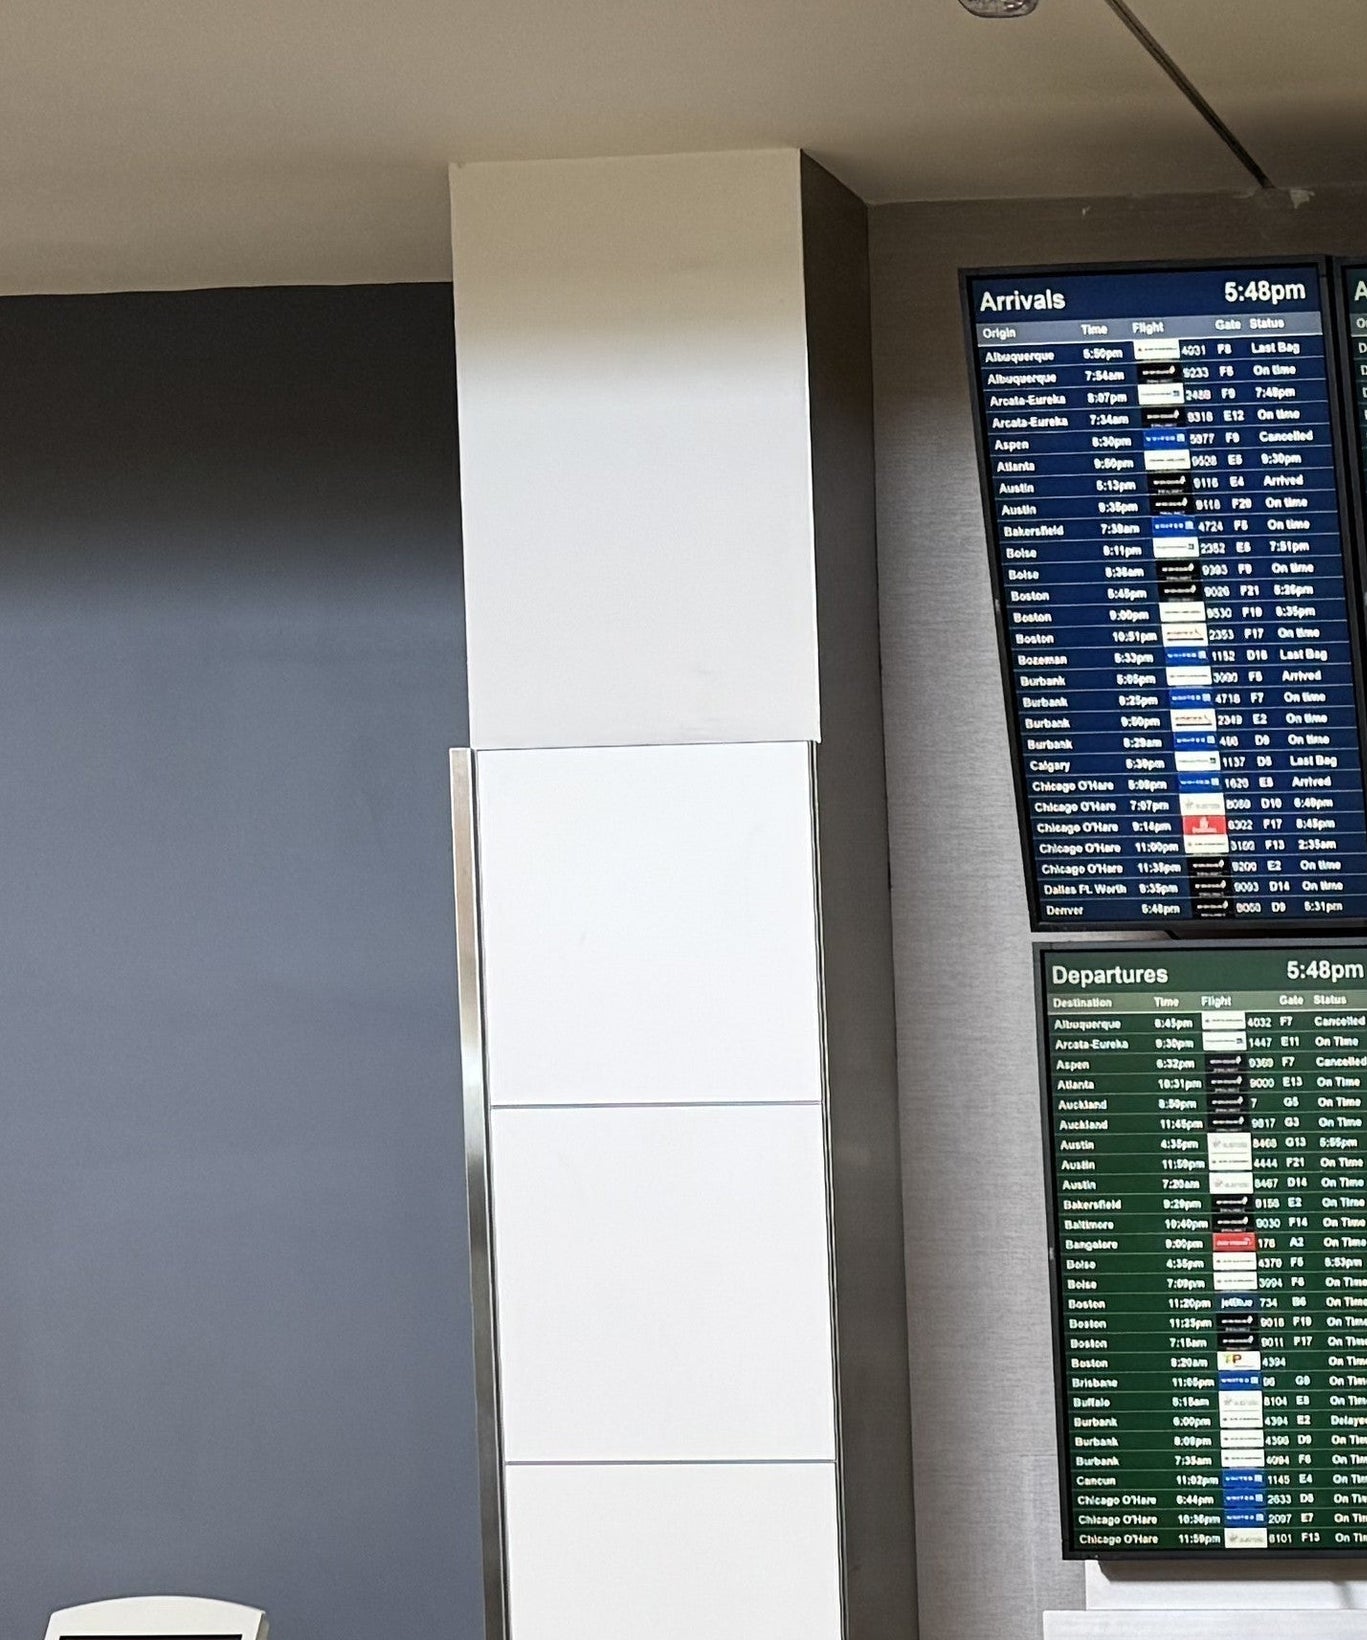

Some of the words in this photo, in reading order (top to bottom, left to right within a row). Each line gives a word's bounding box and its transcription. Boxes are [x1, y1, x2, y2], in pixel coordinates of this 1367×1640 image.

[979, 288, 1066, 312] Arrivals
[1224, 280, 1306, 305] 5:48pm
[982, 327, 1017, 341] Origin
[1080, 323, 1108, 335] Time
[1131, 321, 1164, 335] Flight
[1214, 319, 1242, 331] Gate
[1249, 317, 1285, 330] Status
[1052, 965, 1169, 988] Departures
[1287, 960, 1365, 983] 5:48pm
[1052, 997, 1113, 1008] Destination
[1153, 996, 1180, 1008] Time
[1201, 995, 1232, 1008] Flight
[1279, 994, 1304, 1006] Gate
[1313, 994, 1347, 1005] Status
